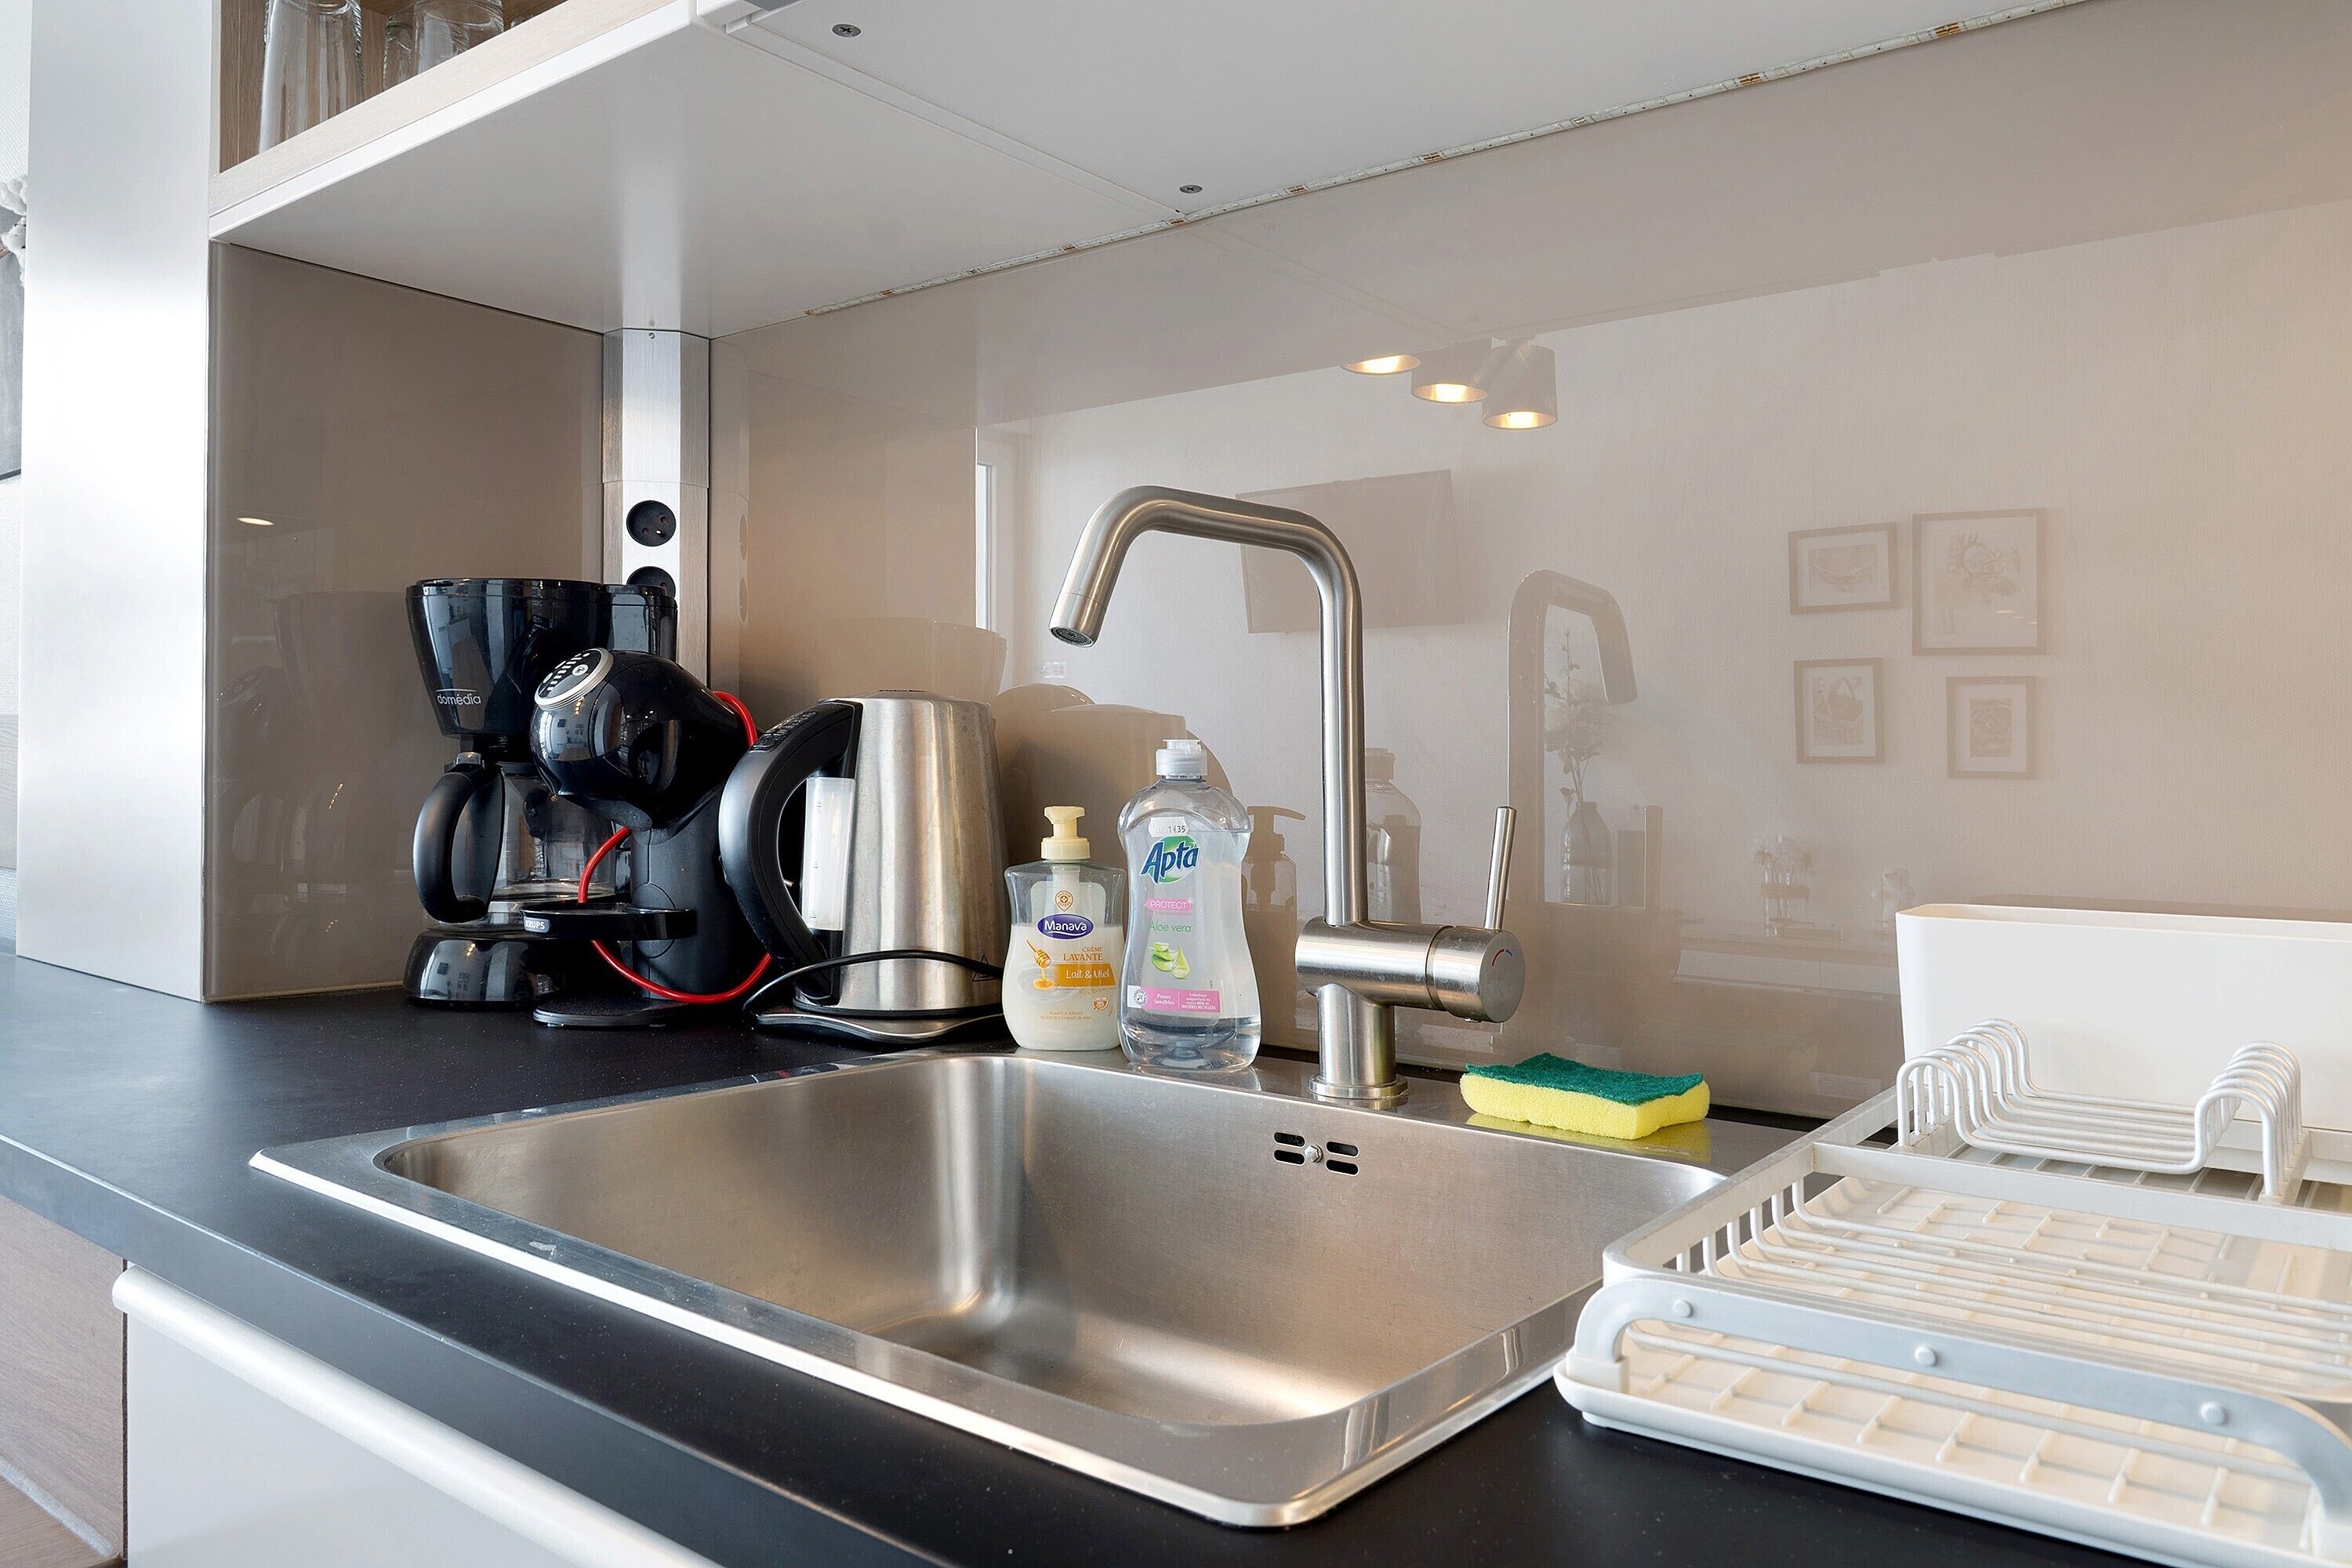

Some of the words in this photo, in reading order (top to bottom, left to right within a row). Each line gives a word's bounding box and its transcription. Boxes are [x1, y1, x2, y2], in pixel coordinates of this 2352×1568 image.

[437, 693, 481, 706] domédia
[1141, 840, 1200, 884] Apta
[525, 920, 546, 930] KRUPS
[1044, 920, 1087, 931] Manava
[1149, 921, 1169, 932] Aloe
[1171, 924, 1192, 933] vera
[1065, 970, 1083, 979] Lait
[1084, 970, 1092, 979] &
[1093, 969, 1111, 978] Miel
